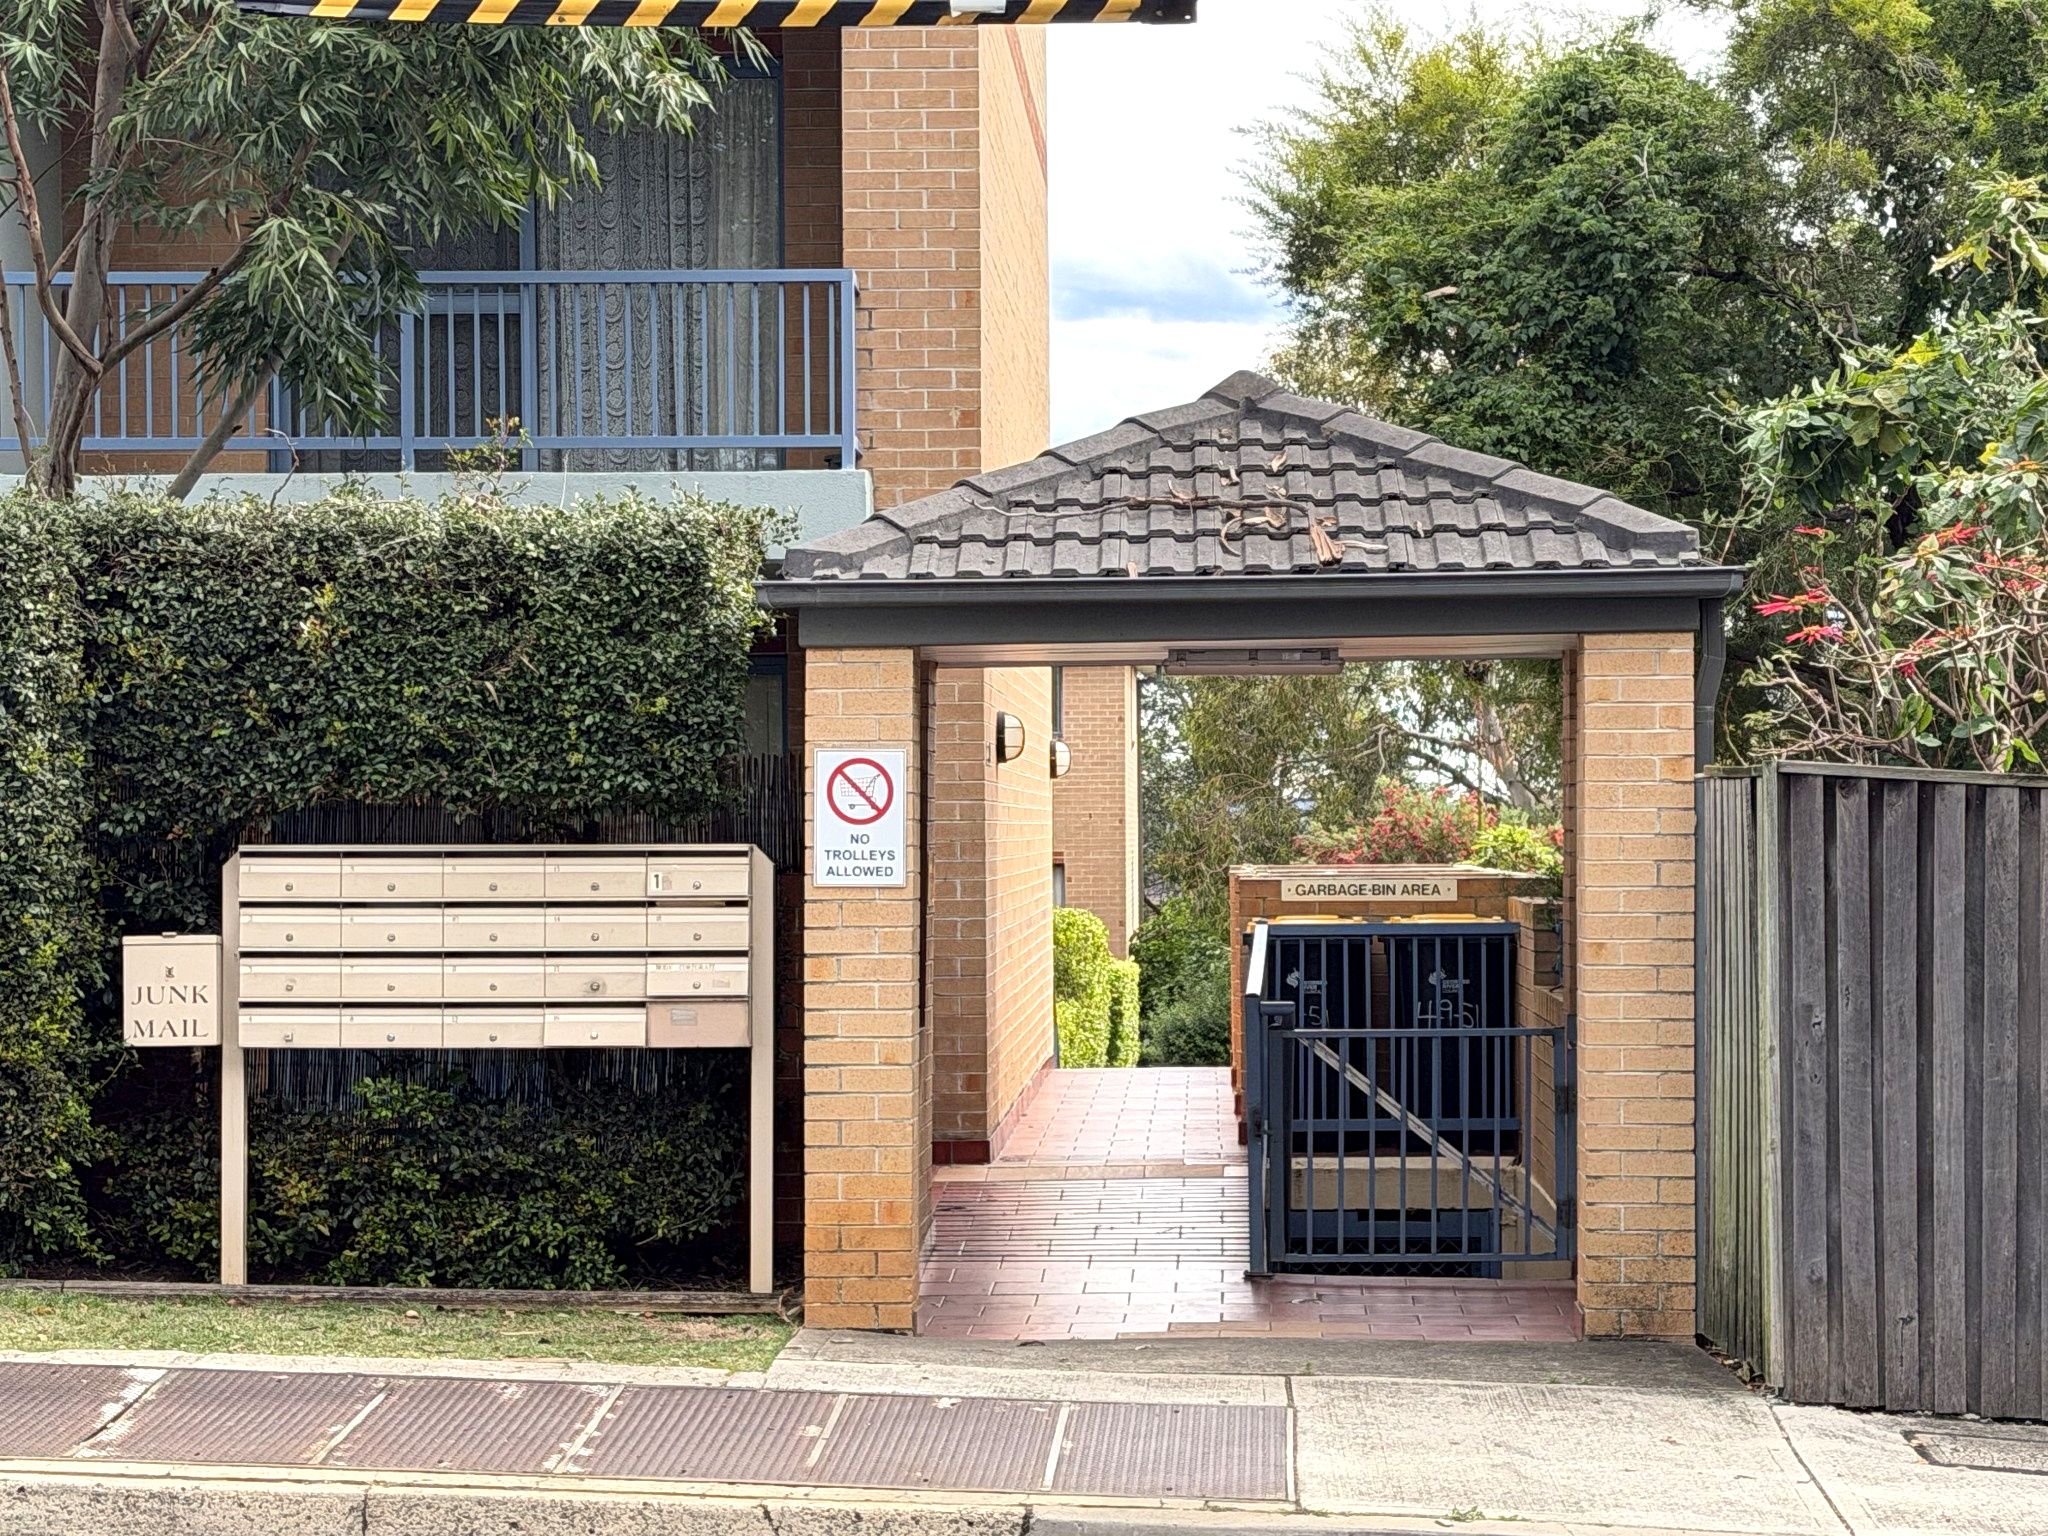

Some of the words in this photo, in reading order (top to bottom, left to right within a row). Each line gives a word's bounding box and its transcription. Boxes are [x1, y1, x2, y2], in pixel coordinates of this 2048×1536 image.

[850, 834, 870, 845] NO
[824, 849, 896, 861] TROLLEYS
[825, 866, 894, 877] ALLOWED
[1401, 883, 1441, 896] AREA
[131, 985, 209, 1006] JUNK
[127, 1019, 209, 1039] MAIL
